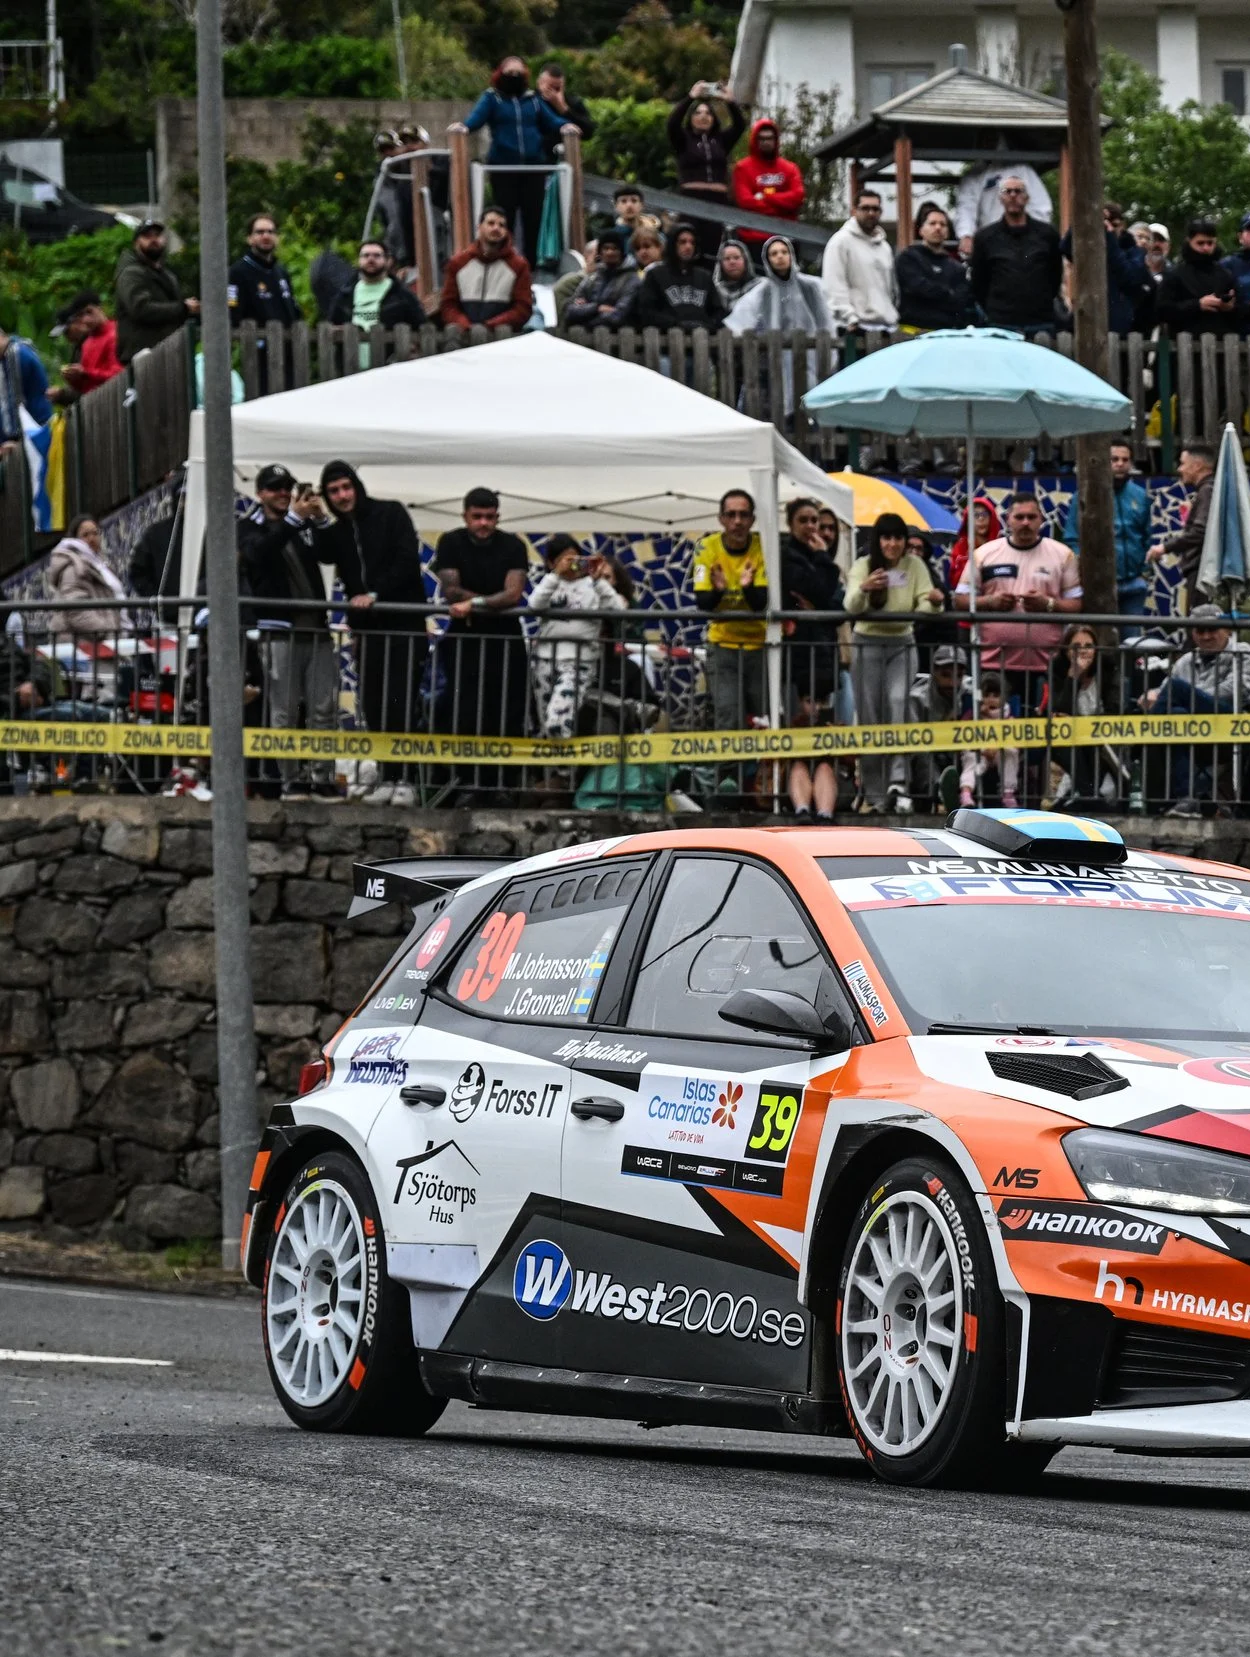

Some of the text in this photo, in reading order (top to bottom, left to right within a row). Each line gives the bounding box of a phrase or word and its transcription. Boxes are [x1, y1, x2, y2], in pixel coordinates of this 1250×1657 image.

[1, 727, 108, 746] ZONA PUBLICO
[123, 730, 210, 749] ZONA PUBLI
[812, 729, 934, 750] ZONA PUBLICO
[953, 723, 1072, 744] ZONA PUBLICO
[1091, 720, 1211, 739] ZONA PUBLICO
[250, 734, 372, 754] ZONA PUBLICO
[391, 738, 512, 759] ZONA PUBLICO
[531, 739, 652, 759] ZONA PUBLICO
[671, 735, 793, 756] ZONA PUBLICO
[907, 860, 1242, 894] MS MUNARETTO
[365, 878, 386, 898] MS
[456, 911, 527, 1002] 39
[501, 953, 592, 980] M.Johansson
[504, 988, 577, 1016] J.Gronvall
[485, 1080, 563, 1118] Forss IT
[683, 1077, 716, 1102] Islas
[648, 1096, 712, 1125] Canarias
[749, 1094, 798, 1151] 39
[992, 1167, 1041, 1189] MS
[408, 1171, 477, 1212] Sjötorps
[429, 1205, 454, 1225] Hus
[571, 1270, 805, 1347] West2000.se
